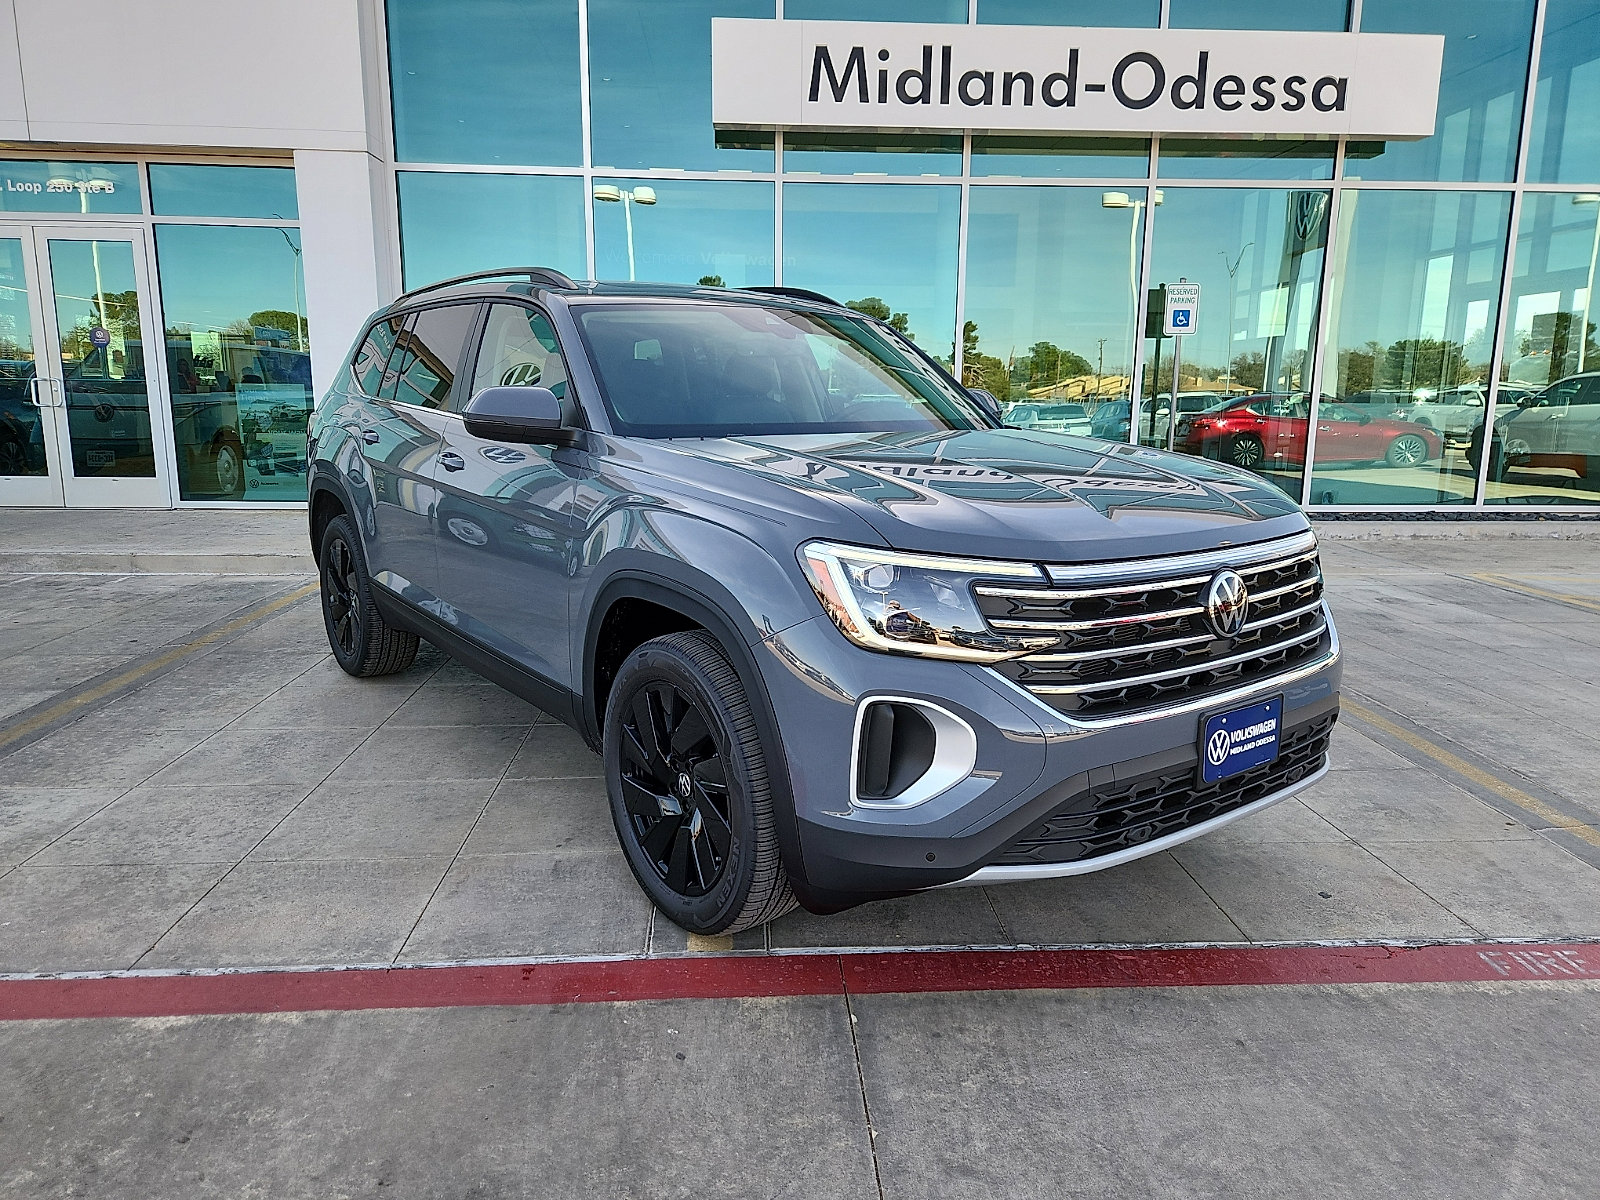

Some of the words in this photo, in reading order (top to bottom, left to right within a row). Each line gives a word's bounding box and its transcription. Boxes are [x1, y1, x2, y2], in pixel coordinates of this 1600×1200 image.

[807, 44, 1349, 113] Midland-Odessa
[7, 179, 42, 194] Loop
[46, 181, 73, 193] 250
[78, 181, 101, 194] Ste
[105, 181, 115, 194] B
[1168, 288, 1198, 296] RESERVED
[1230, 718, 1277, 743] VOLKSWAGEN
[1230, 741, 1256, 755] MIDLAND
[1255, 734, 1276, 747] ODESSA
[715, 836, 740, 908] NEXEN
[1476, 949, 1600, 976] FIRE
